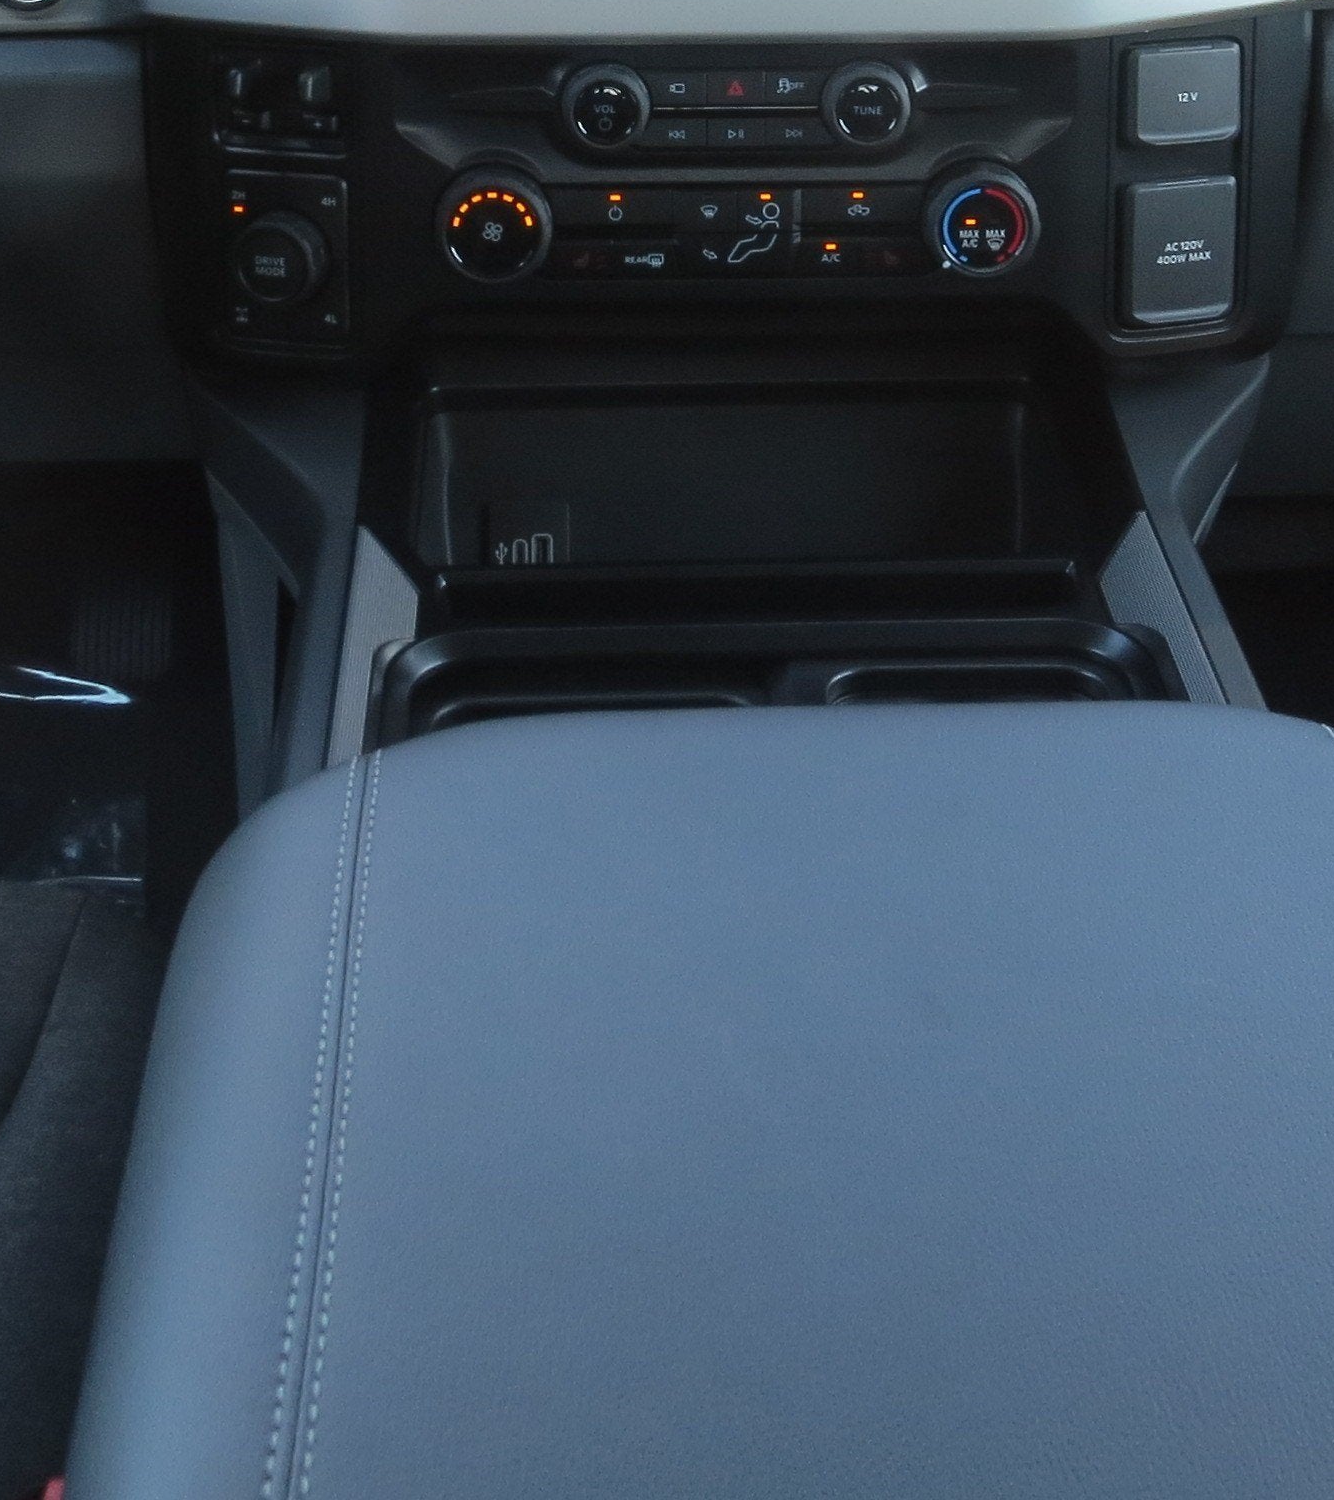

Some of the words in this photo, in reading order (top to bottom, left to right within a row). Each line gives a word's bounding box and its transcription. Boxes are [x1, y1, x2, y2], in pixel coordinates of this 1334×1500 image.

[594, 105, 616, 114] VOL
[853, 106, 883, 115] TUNE
[959, 229, 979, 238] MAX
[985, 229, 1006, 238] MAX
[1165, 242, 1179, 252] AC
[255, 255, 285, 266] DRIVE
[821, 253, 841, 263] A/C
[1157, 253, 1186, 264] 400W
[1188, 251, 1211, 262] MAX
[255, 266, 286, 277] MODE
